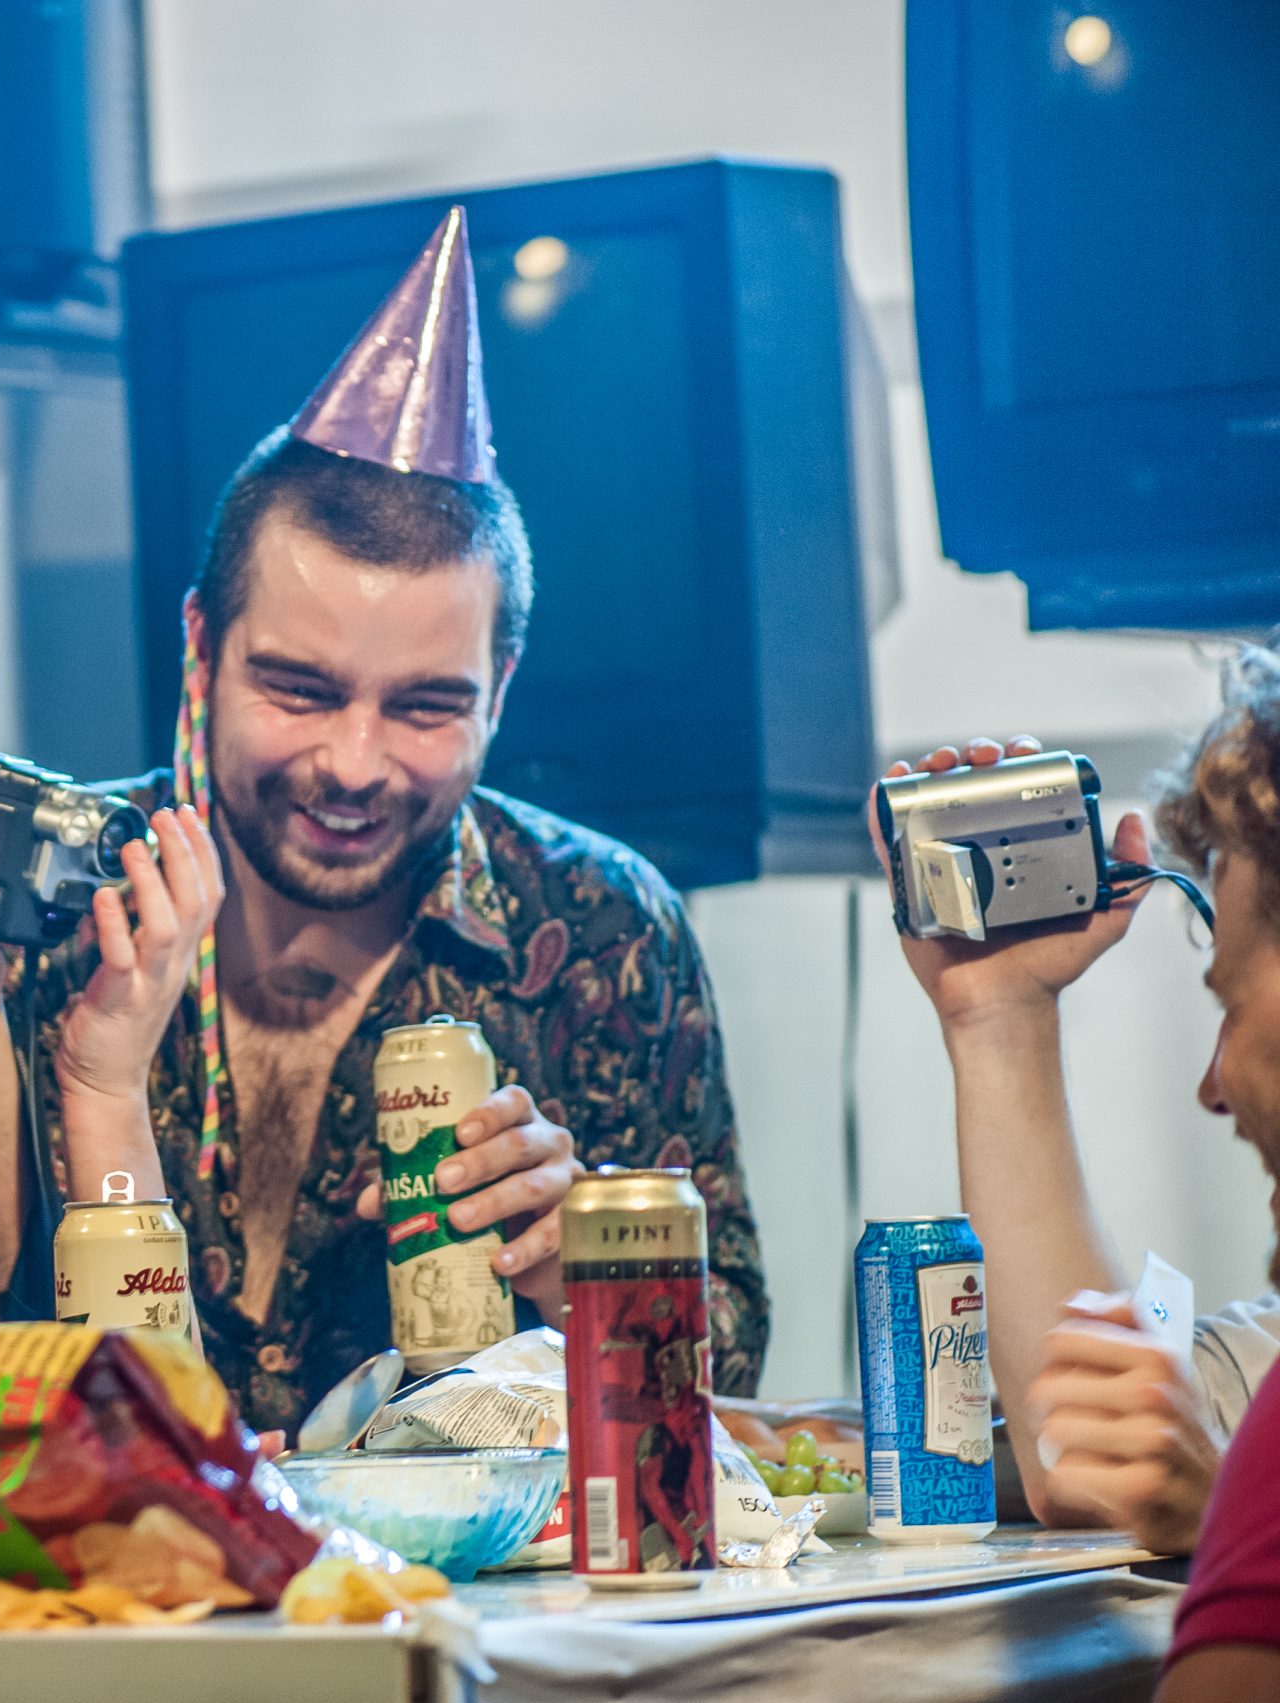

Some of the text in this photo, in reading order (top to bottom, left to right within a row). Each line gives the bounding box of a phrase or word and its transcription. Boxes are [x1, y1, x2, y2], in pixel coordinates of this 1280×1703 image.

[1021, 784, 1066, 801] SONY
[376, 1084, 450, 1114] ldaris
[618, 1223, 671, 1244] PINT
[548, 1506, 564, 1526] N
